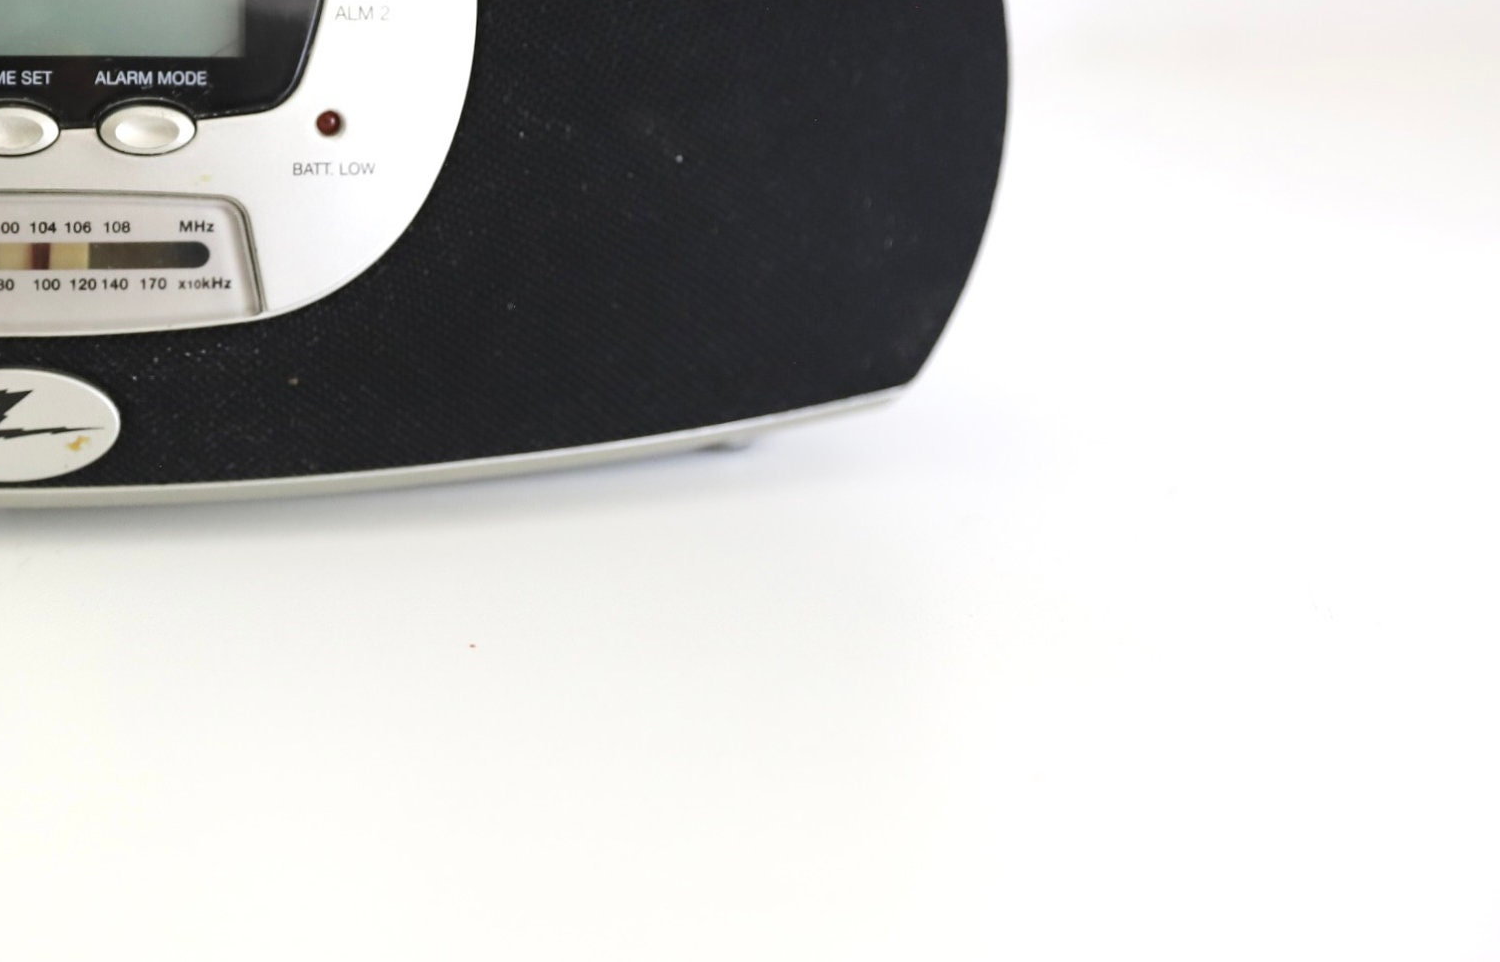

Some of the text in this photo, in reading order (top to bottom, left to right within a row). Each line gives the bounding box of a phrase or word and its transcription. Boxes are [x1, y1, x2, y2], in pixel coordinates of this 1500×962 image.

[334, 5, 390, 22] ALM 2
[19, 70, 53, 86] SET
[94, 71, 207, 85] ALARM MODE
[339, 161, 376, 177] LOW
[30, 221, 57, 235] 104
[64, 221, 92, 234] 106
[104, 221, 131, 234] 108
[179, 220, 214, 233] MHz
[34, 278, 61, 291] 100
[70, 277, 97, 291] 120
[102, 277, 129, 291] 140
[140, 277, 168, 291] 170
